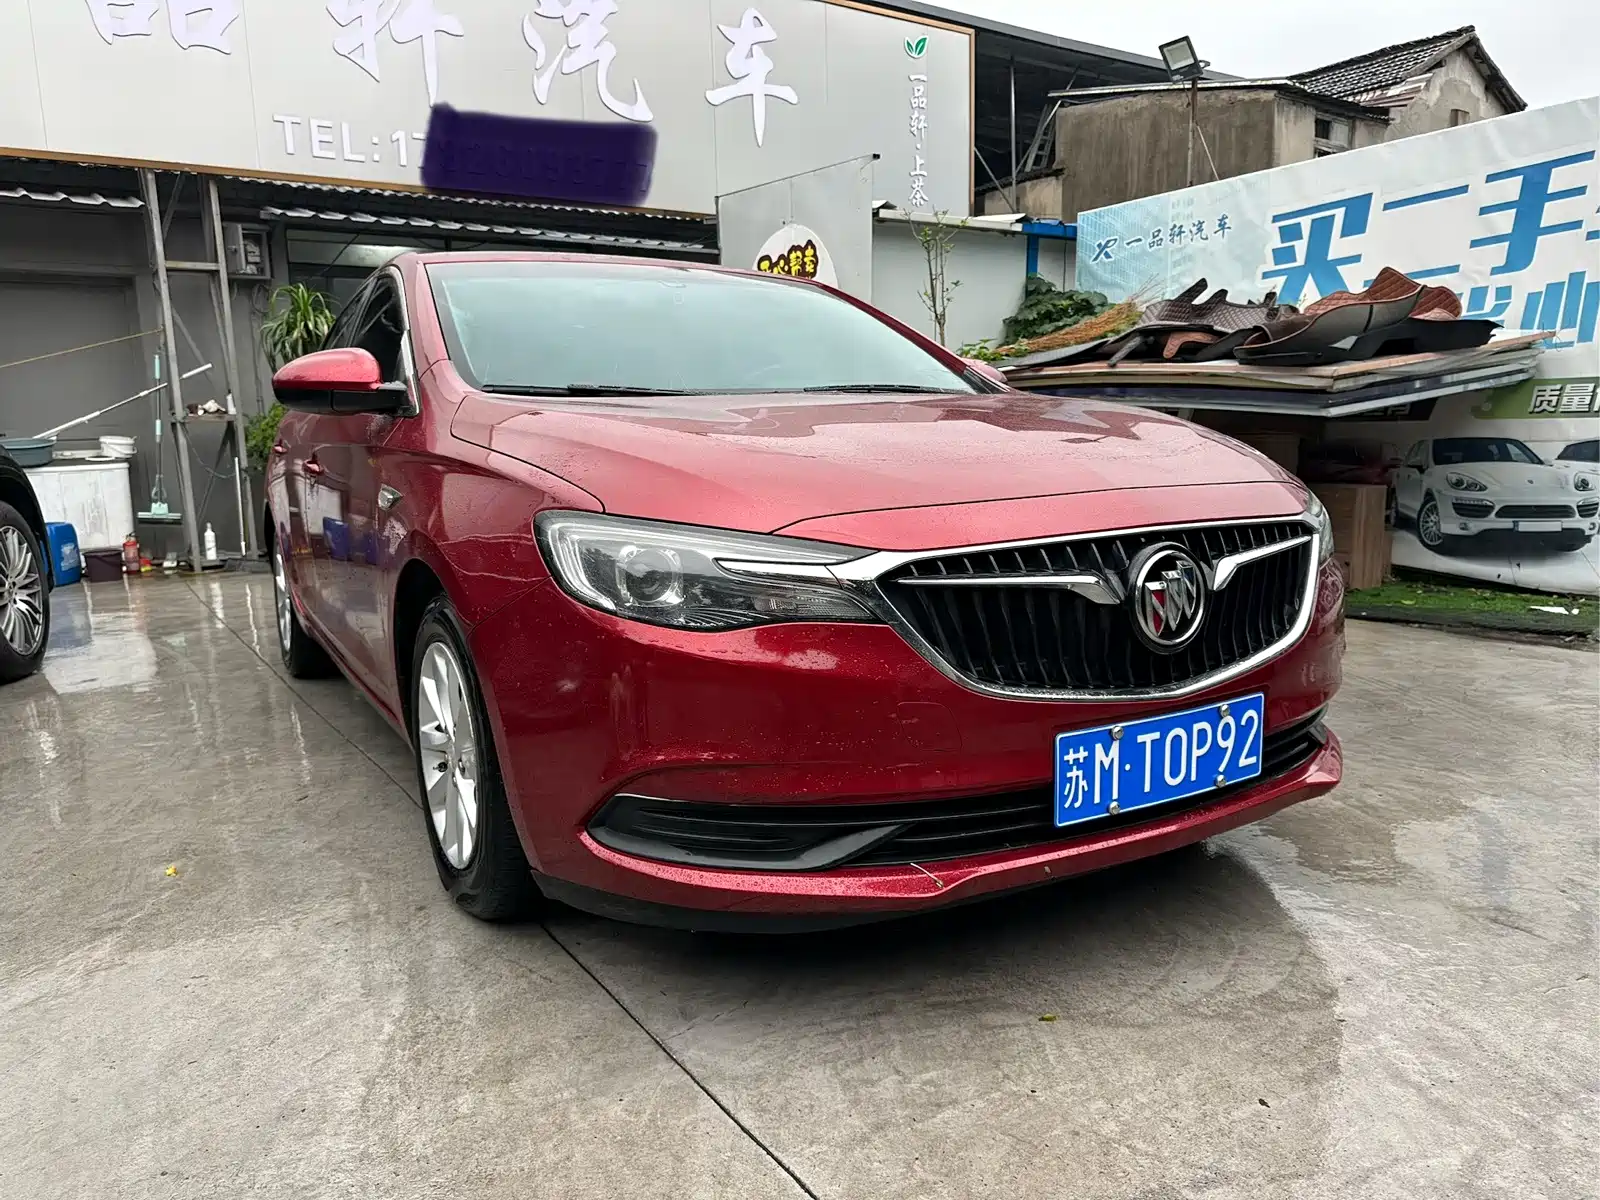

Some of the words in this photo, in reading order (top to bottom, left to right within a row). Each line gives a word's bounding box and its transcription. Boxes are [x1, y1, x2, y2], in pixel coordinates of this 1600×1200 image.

[1126, 213, 1232, 249] 一品轩汽车
[1262, 150, 1600, 306] 买二手
[1528, 382, 1600, 415] 质量
